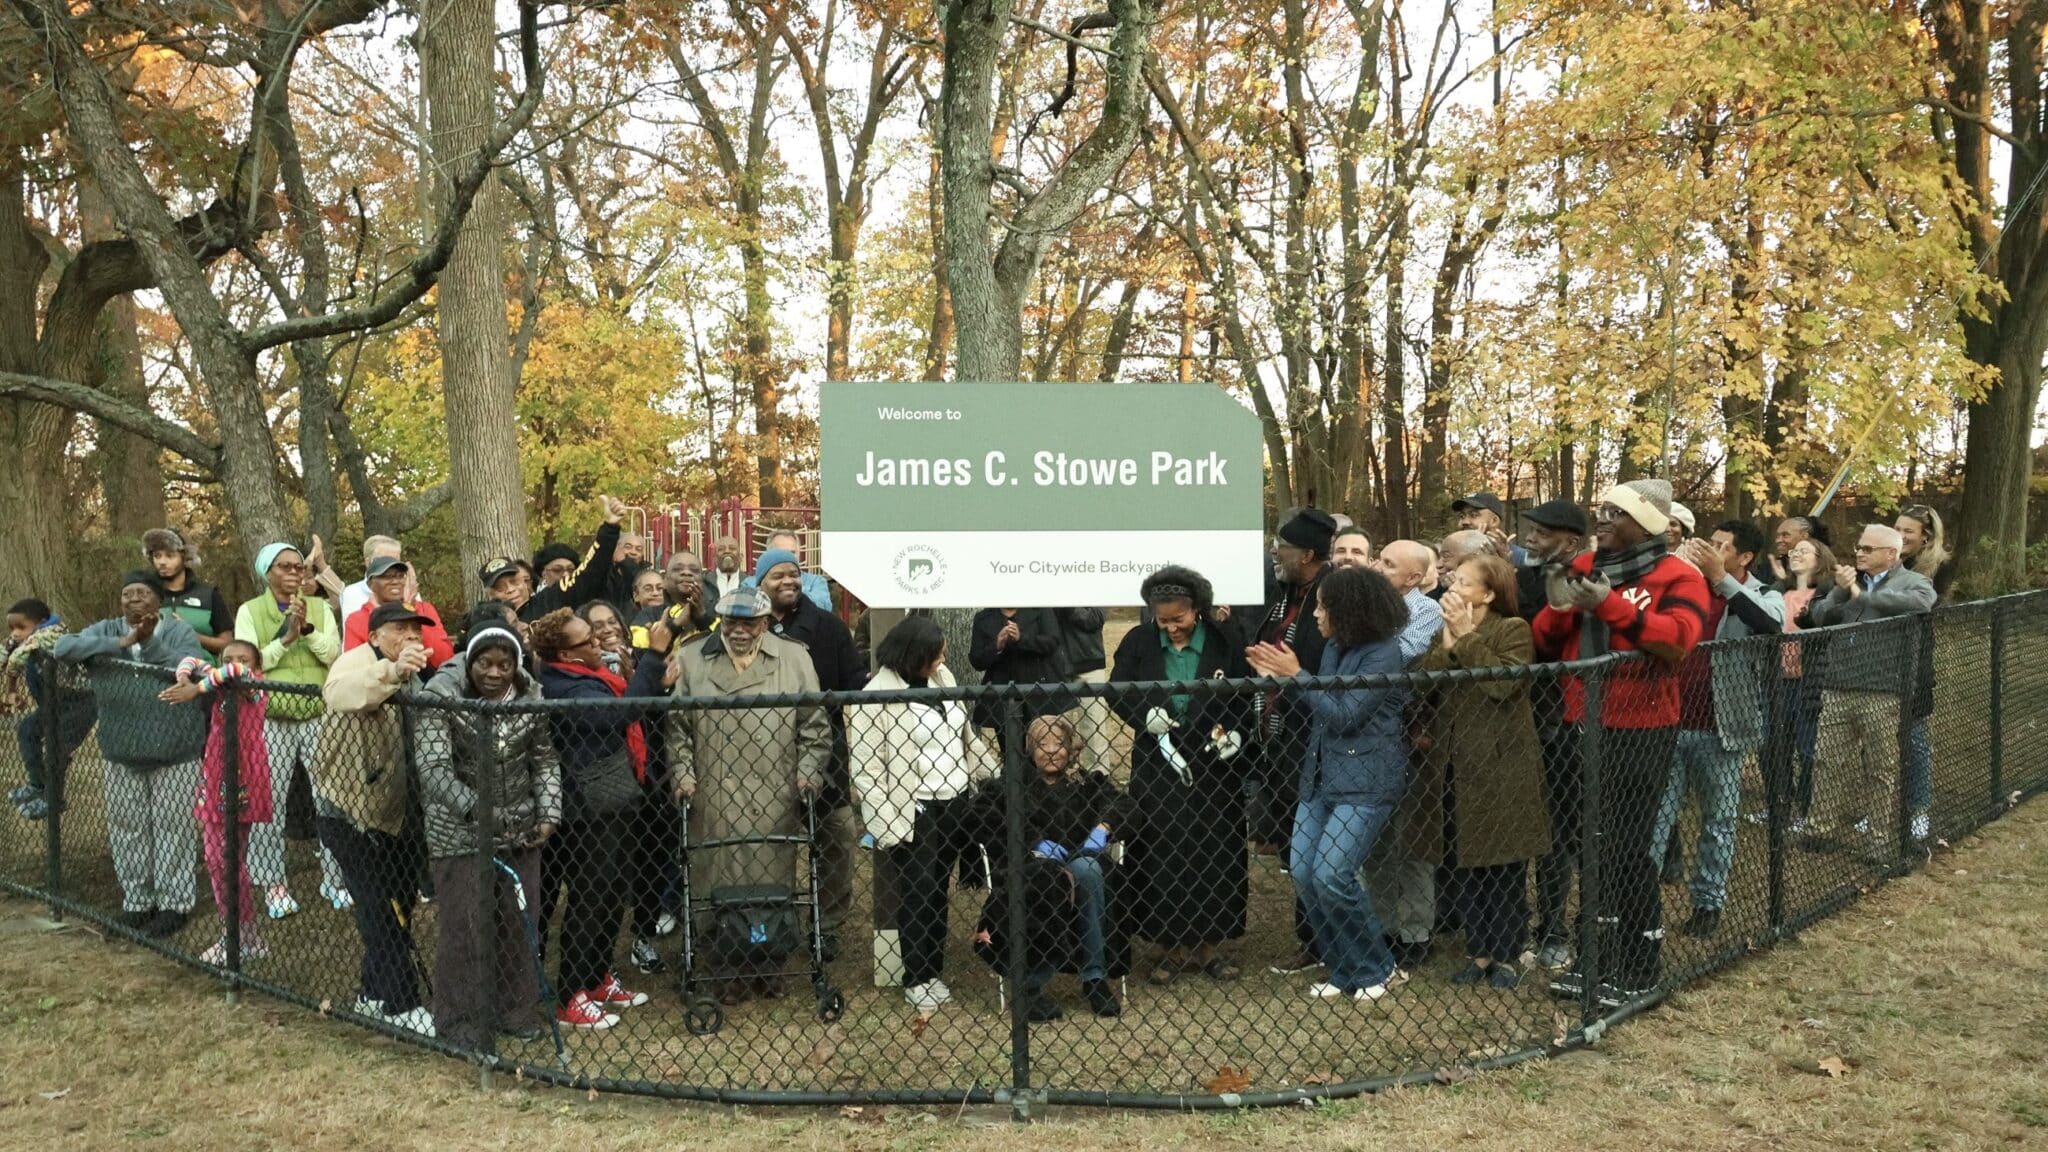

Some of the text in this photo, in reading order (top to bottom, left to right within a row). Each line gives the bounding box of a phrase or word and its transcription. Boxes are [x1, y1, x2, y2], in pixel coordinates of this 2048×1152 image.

[877, 407, 963, 421] Welcome to
[855, 450, 1228, 486] James C. Stowe Park
[892, 544, 948, 570] NEW ROCHELLE
[990, 560, 1025, 574] Your
[1029, 560, 1096, 576] Citywide
